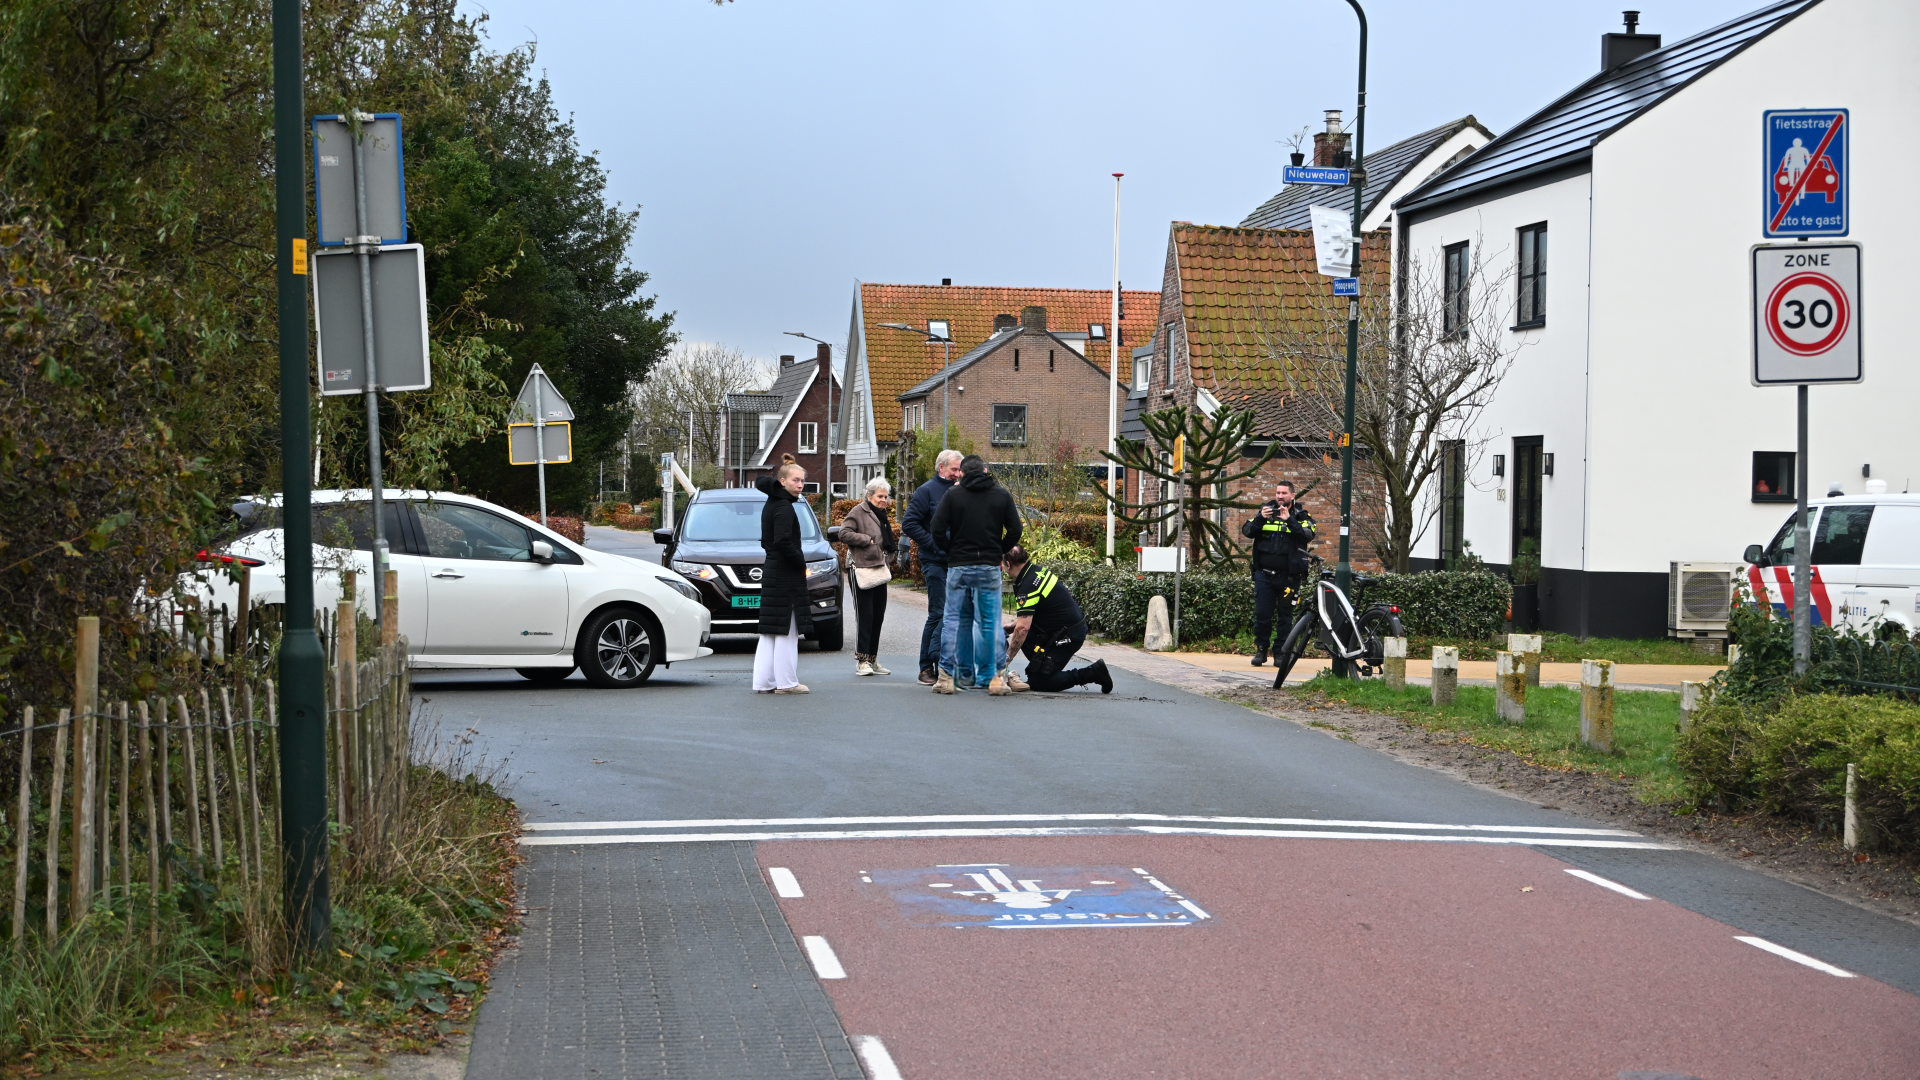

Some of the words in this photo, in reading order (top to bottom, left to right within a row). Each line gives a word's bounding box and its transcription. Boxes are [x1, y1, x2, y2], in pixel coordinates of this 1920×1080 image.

[1776, 118, 1834, 129] fietsstraa
[1288, 169, 1345, 180] Nieuwelaan
[1779, 217, 1799, 226] uto
[1801, 216, 1813, 226] te
[1815, 215, 1842, 228] gast
[1784, 254, 1830, 267] ZONE
[1782, 299, 1833, 329] 30
[1838, 605, 1867, 617] PLITIE
